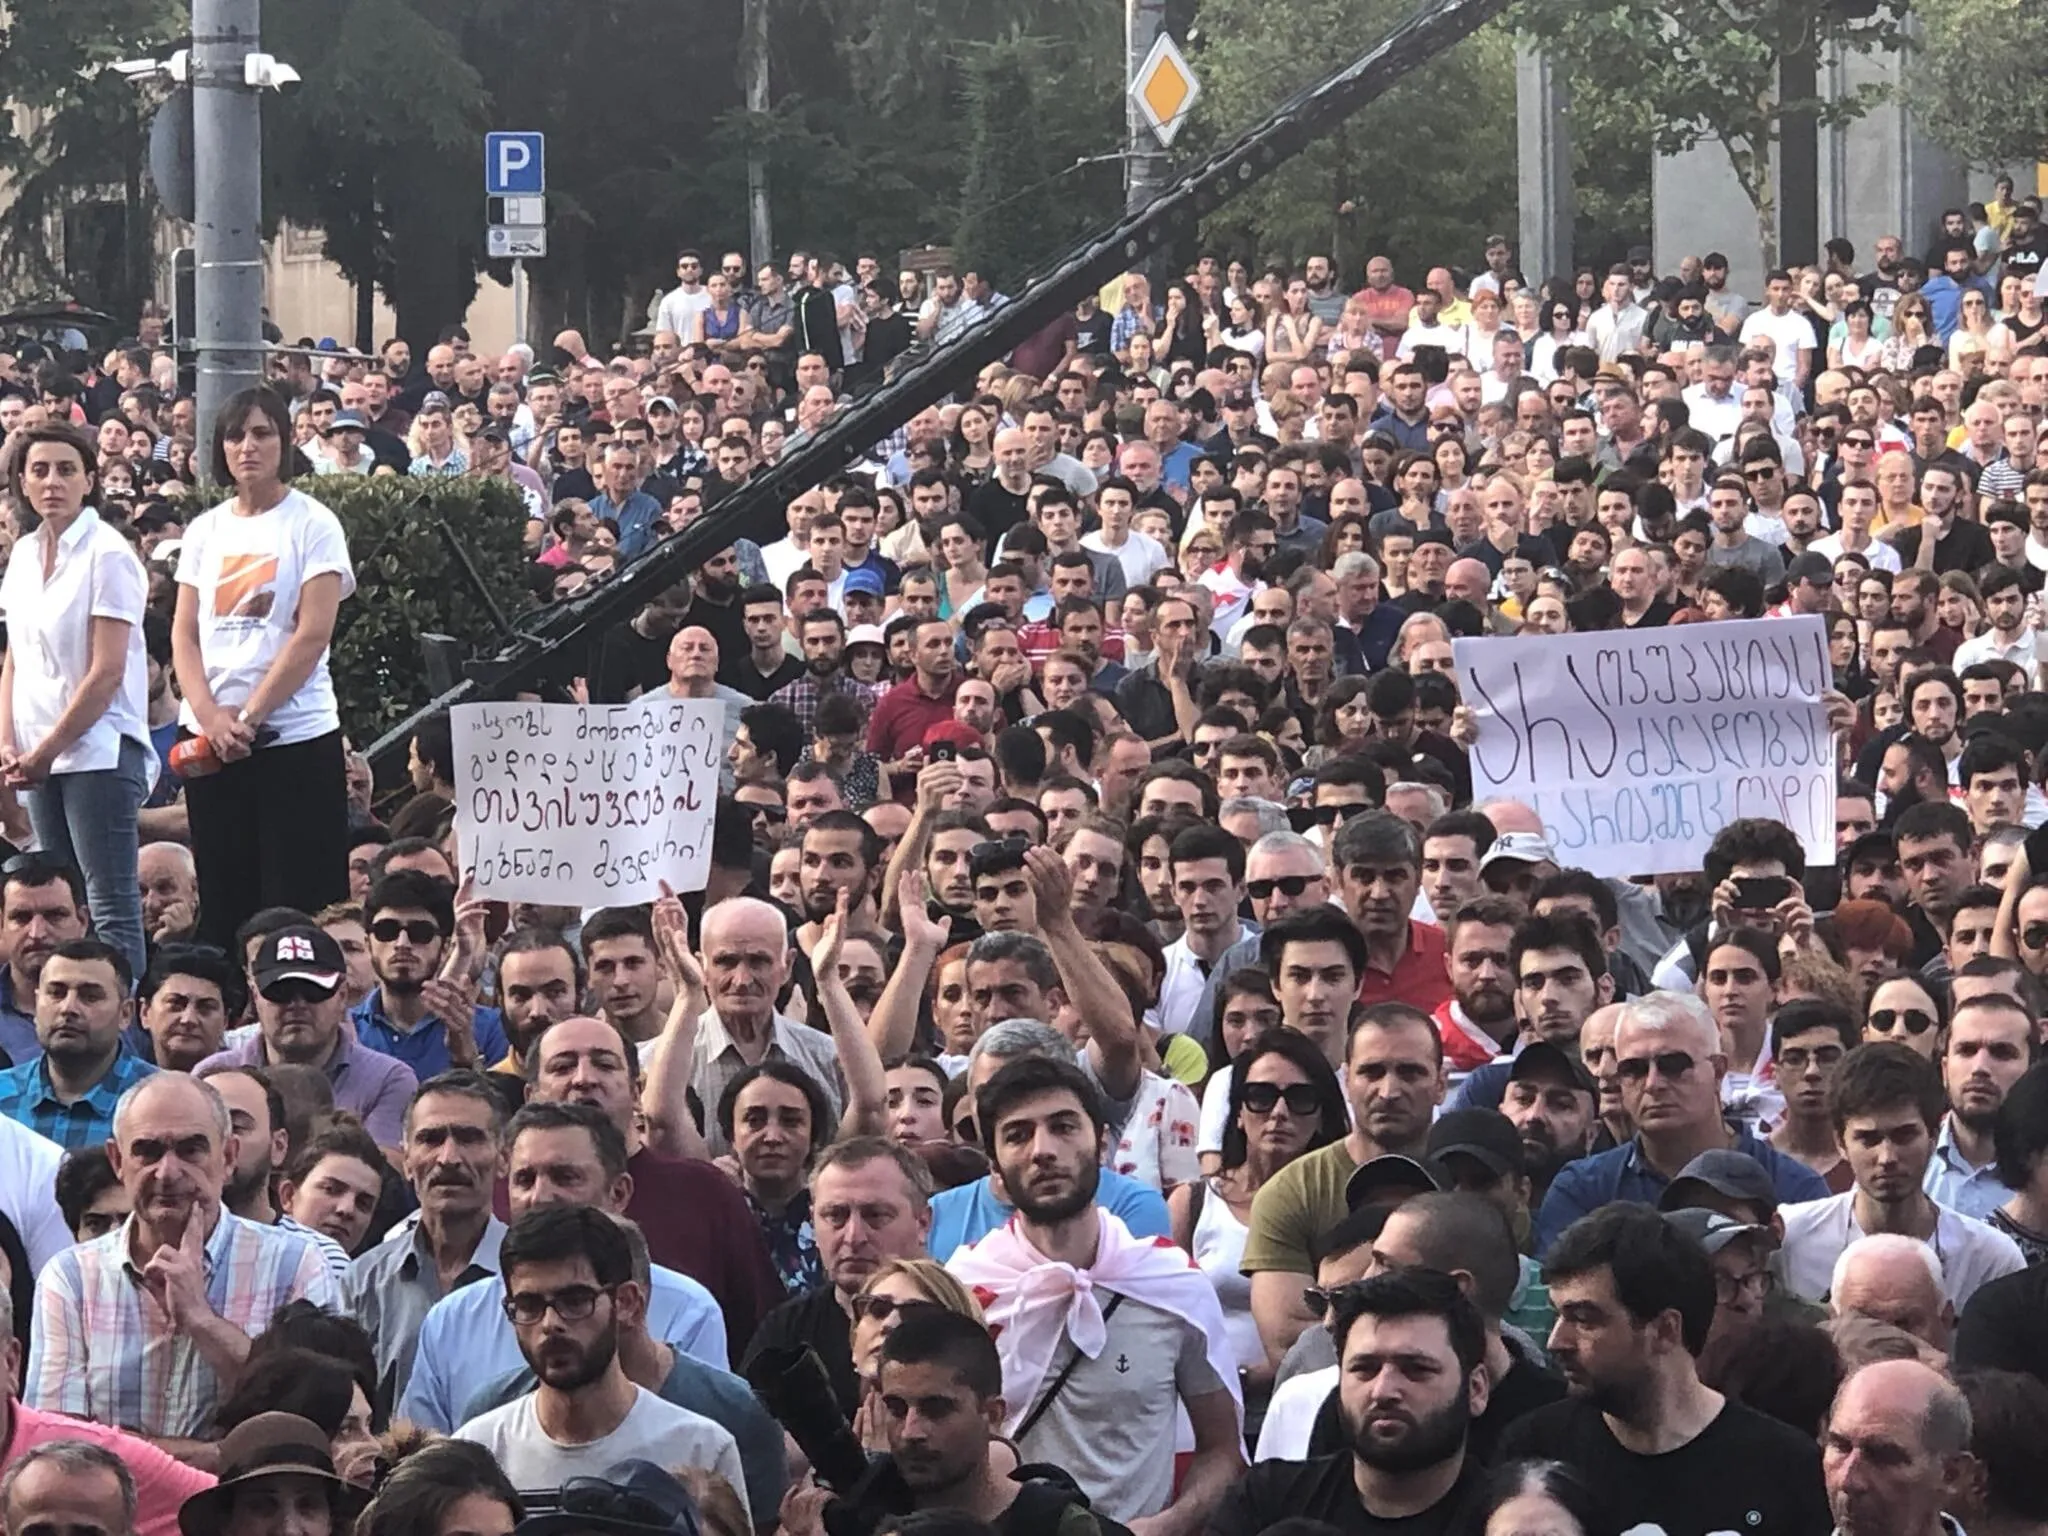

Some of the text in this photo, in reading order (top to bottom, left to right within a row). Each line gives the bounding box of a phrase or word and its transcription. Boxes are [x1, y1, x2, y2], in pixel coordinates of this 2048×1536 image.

[499, 140, 531, 187] P
[576, 704, 706, 741] მონობაში
[1469, 654, 1617, 785] არა
[472, 779, 702, 832] თავისუფლების
[465, 834, 574, 886] ძებნაში
